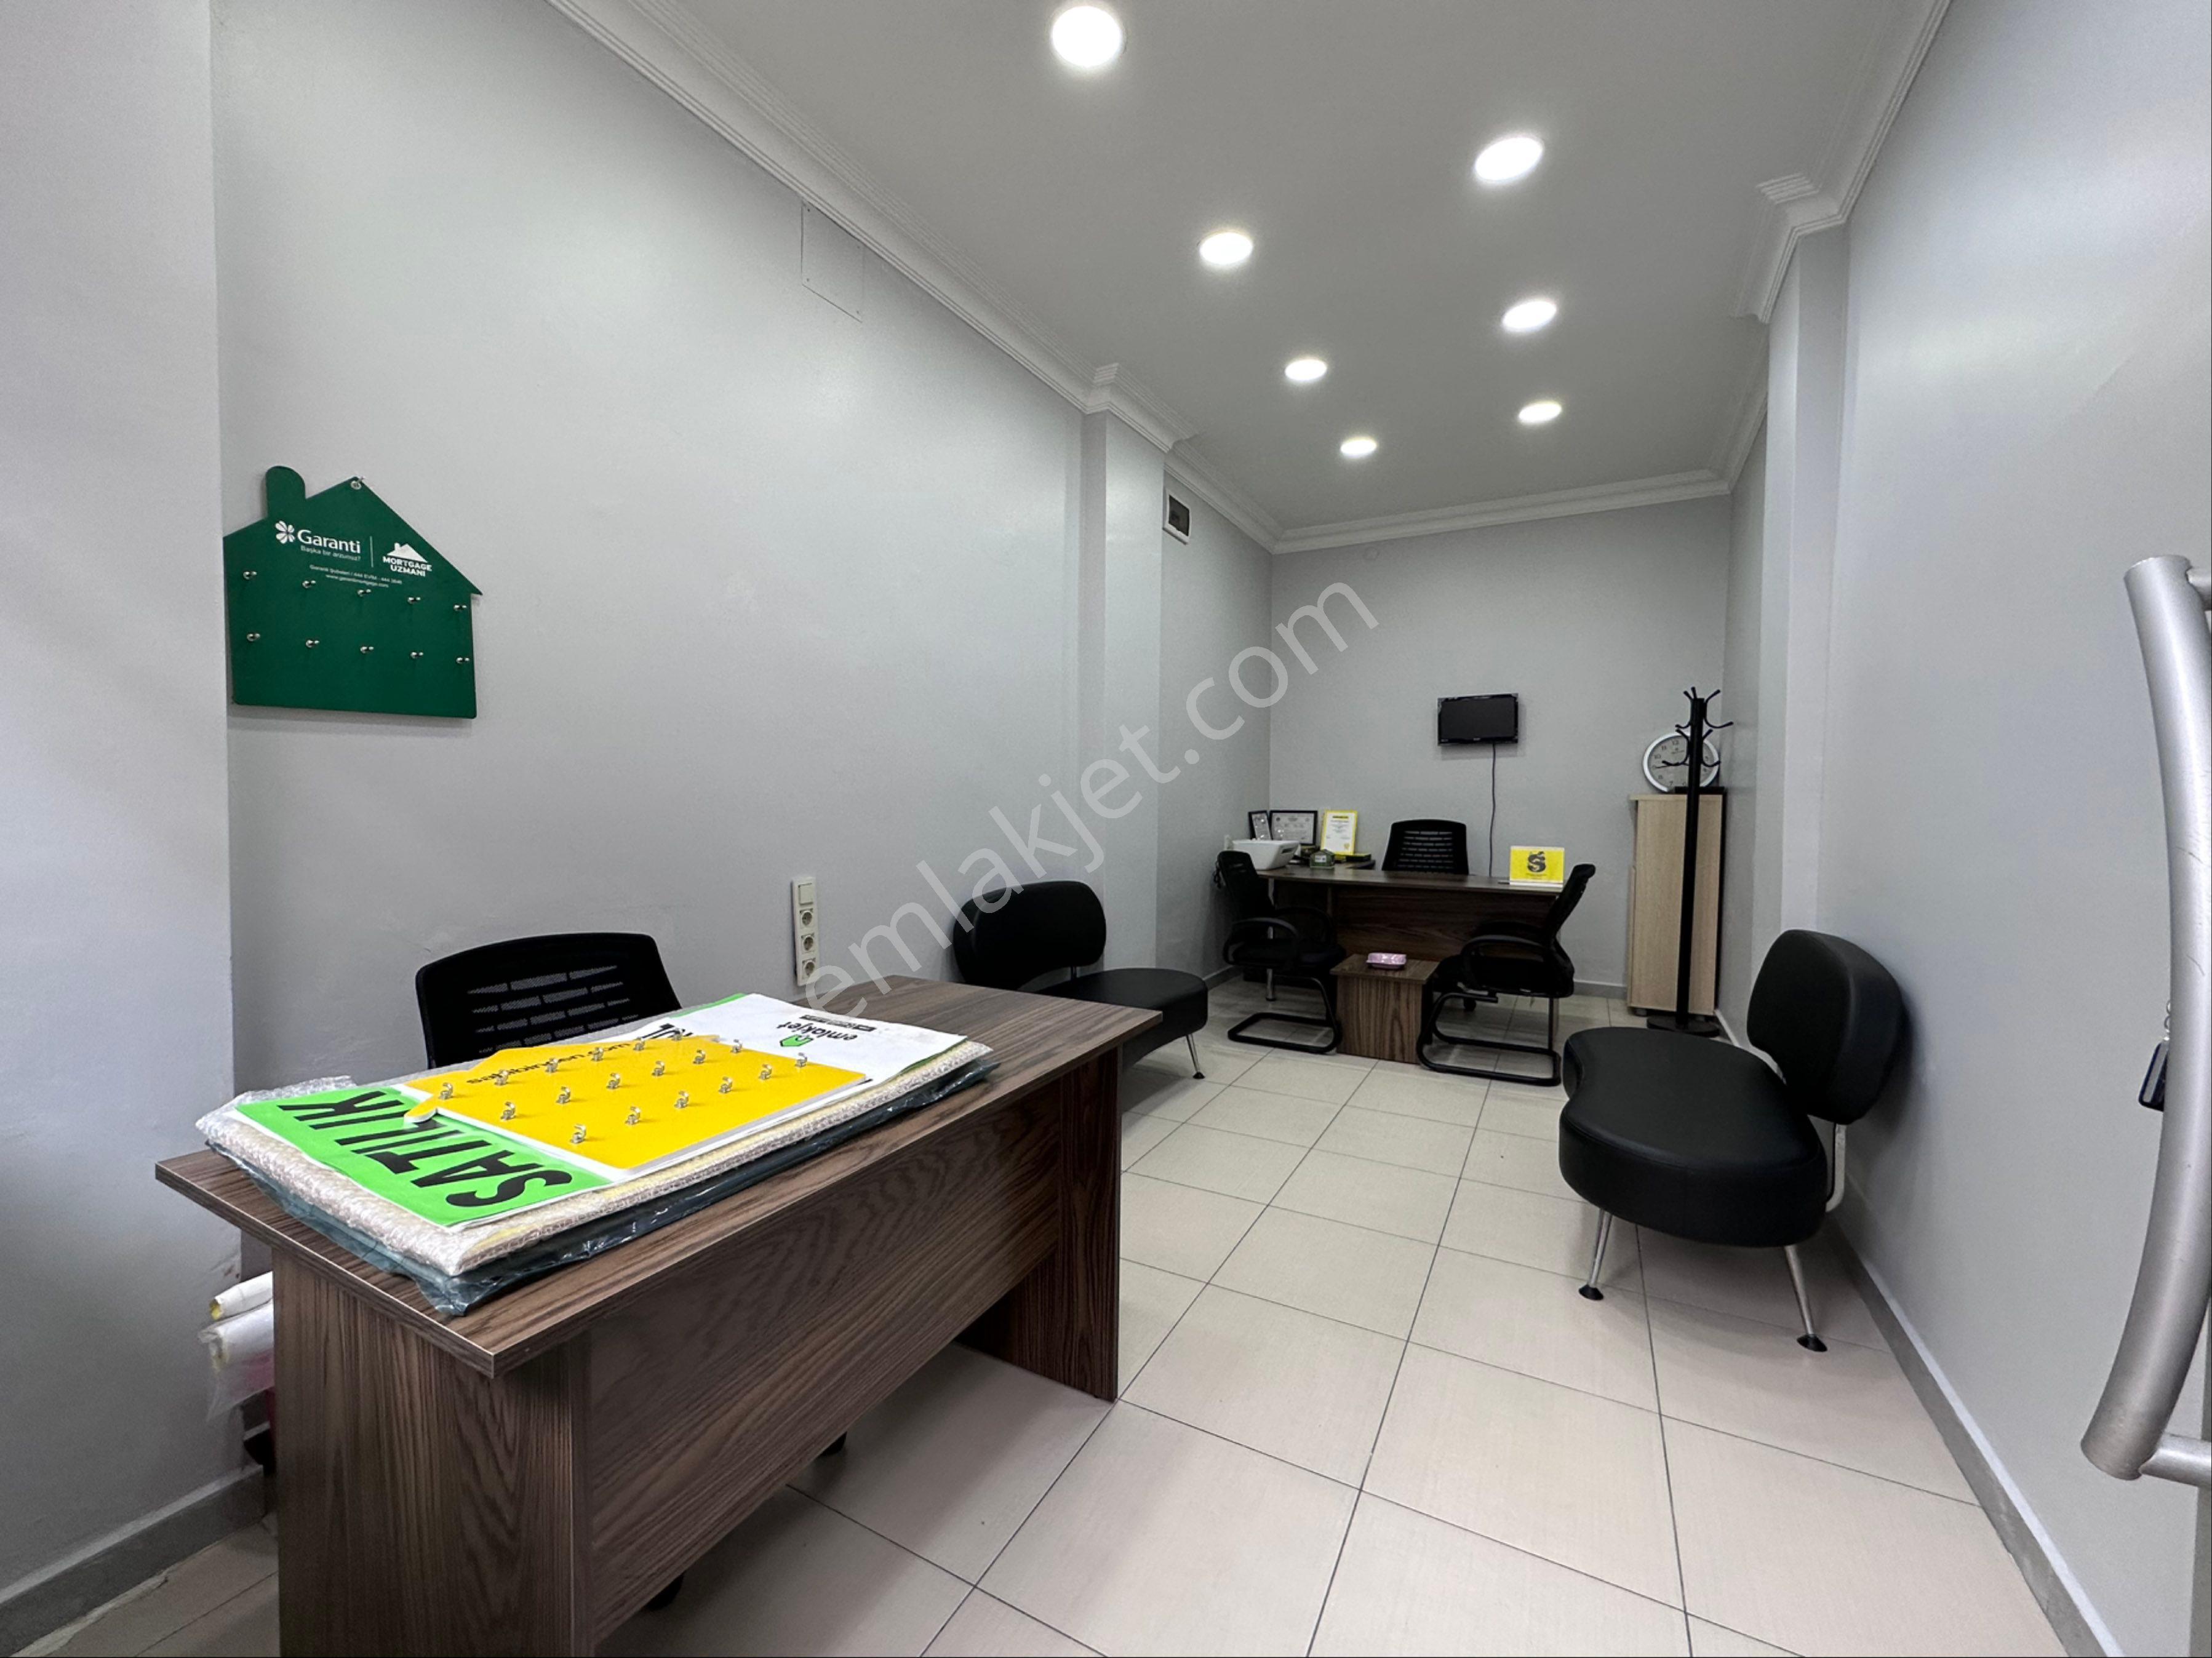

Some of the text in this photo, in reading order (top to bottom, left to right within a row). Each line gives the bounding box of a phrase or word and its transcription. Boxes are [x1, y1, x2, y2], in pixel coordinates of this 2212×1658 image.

[297, 529, 361, 554] Garanti
[383, 556, 433, 572] MORTGAGE
[390, 564, 426, 577] UZMANI
[777, 1021, 858, 1040] emlakjet
[277, 1091, 572, 1207] SATILIK
